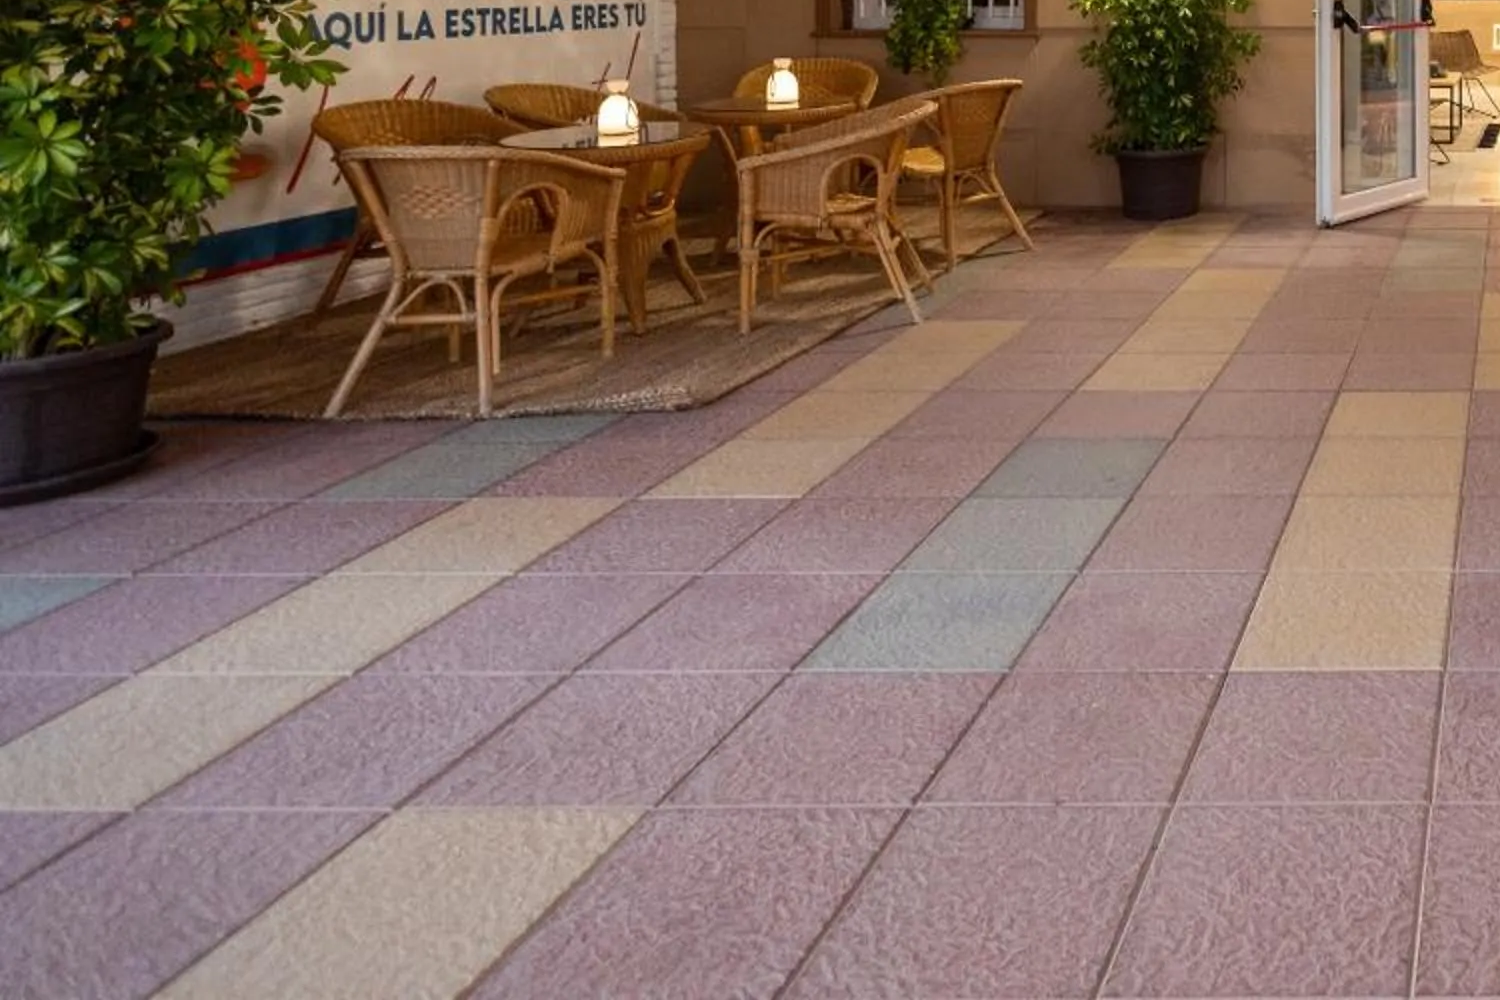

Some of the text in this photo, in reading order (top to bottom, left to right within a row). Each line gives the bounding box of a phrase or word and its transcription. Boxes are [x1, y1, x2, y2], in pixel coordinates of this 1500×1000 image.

[397, 10, 435, 41] LA
[445, 6, 564, 39] ESTRELLA
[571, 3, 619, 31] ERES
